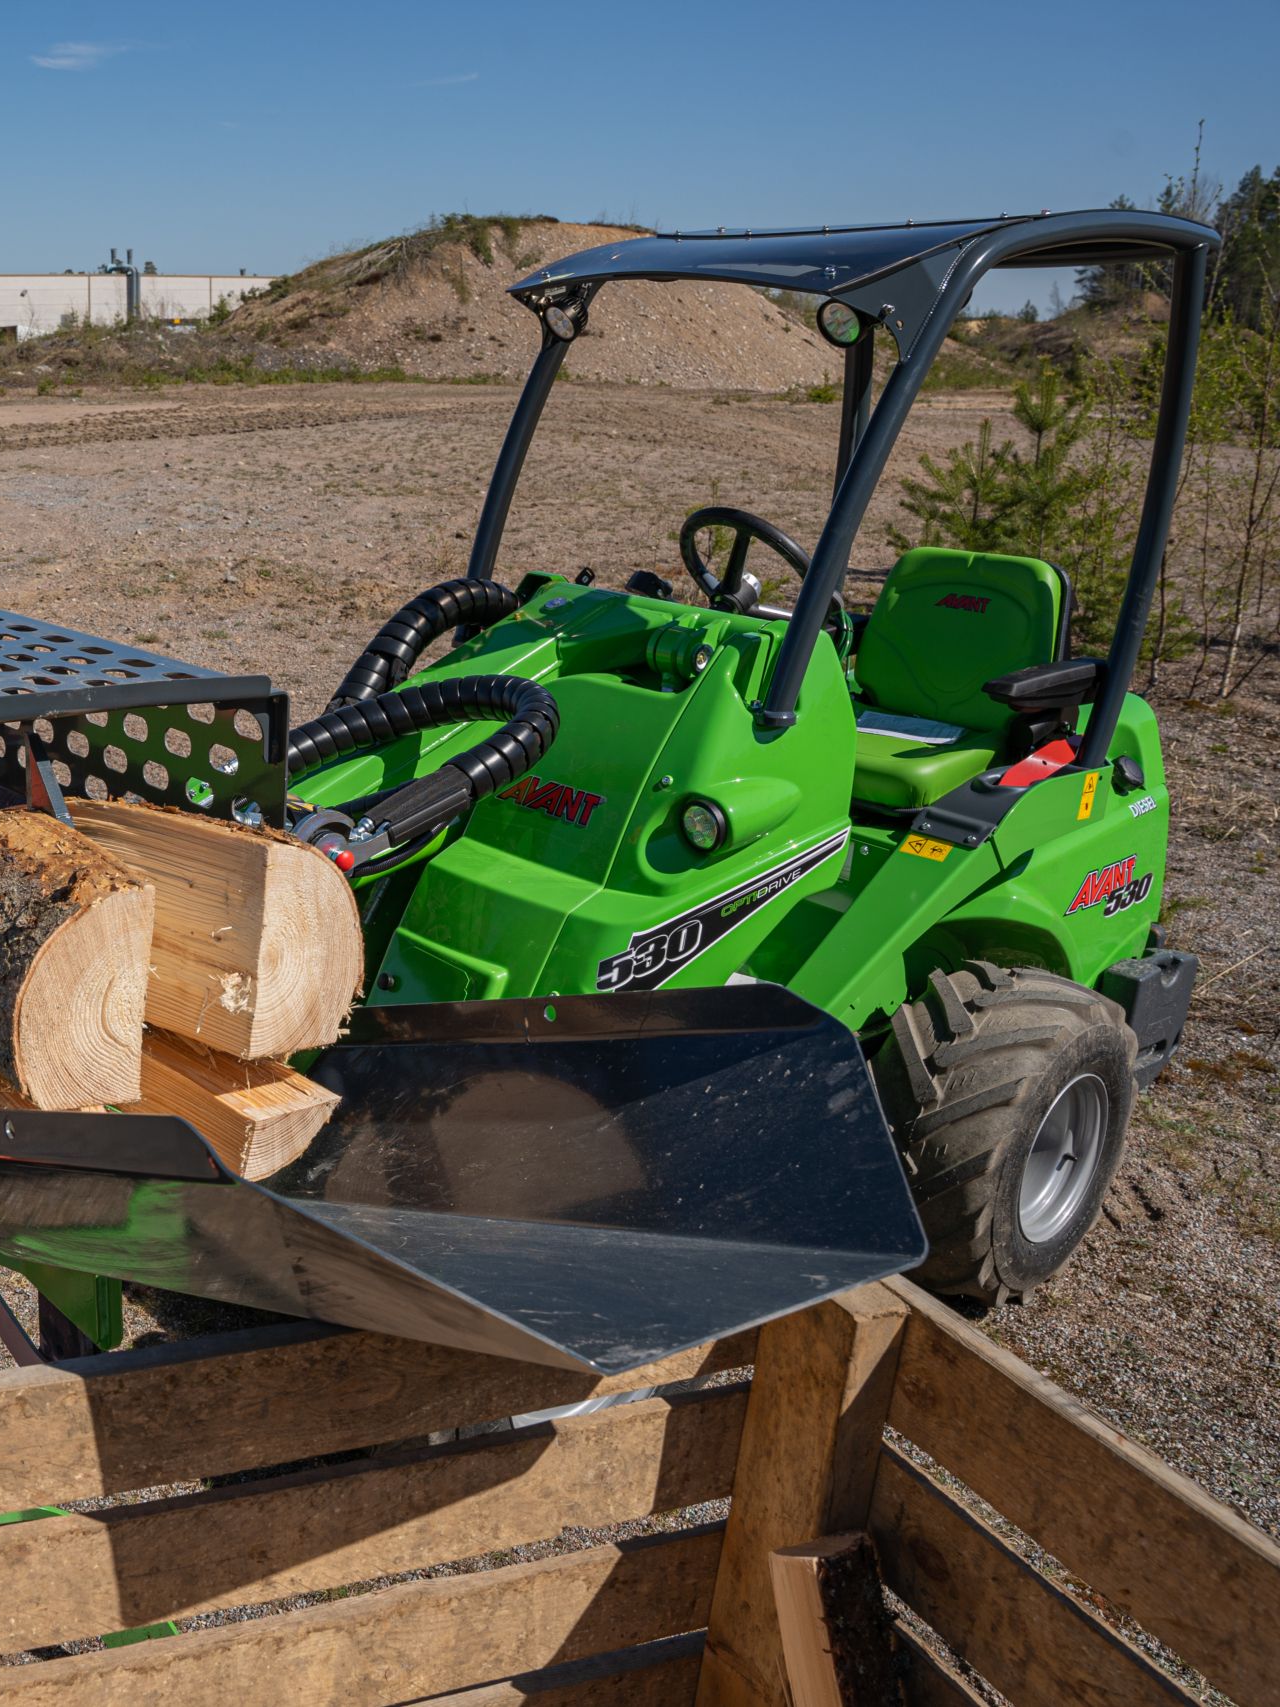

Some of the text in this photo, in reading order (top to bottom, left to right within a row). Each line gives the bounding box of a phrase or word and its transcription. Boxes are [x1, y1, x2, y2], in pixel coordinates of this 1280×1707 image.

[933, 592, 991, 613] AVANT
[496, 776, 606, 826] AVANT
[1128, 796, 1157, 818] DIESEL
[1063, 853, 1154, 918] AVANT 530
[596, 868, 802, 991] 530 OPTIDRIVE
